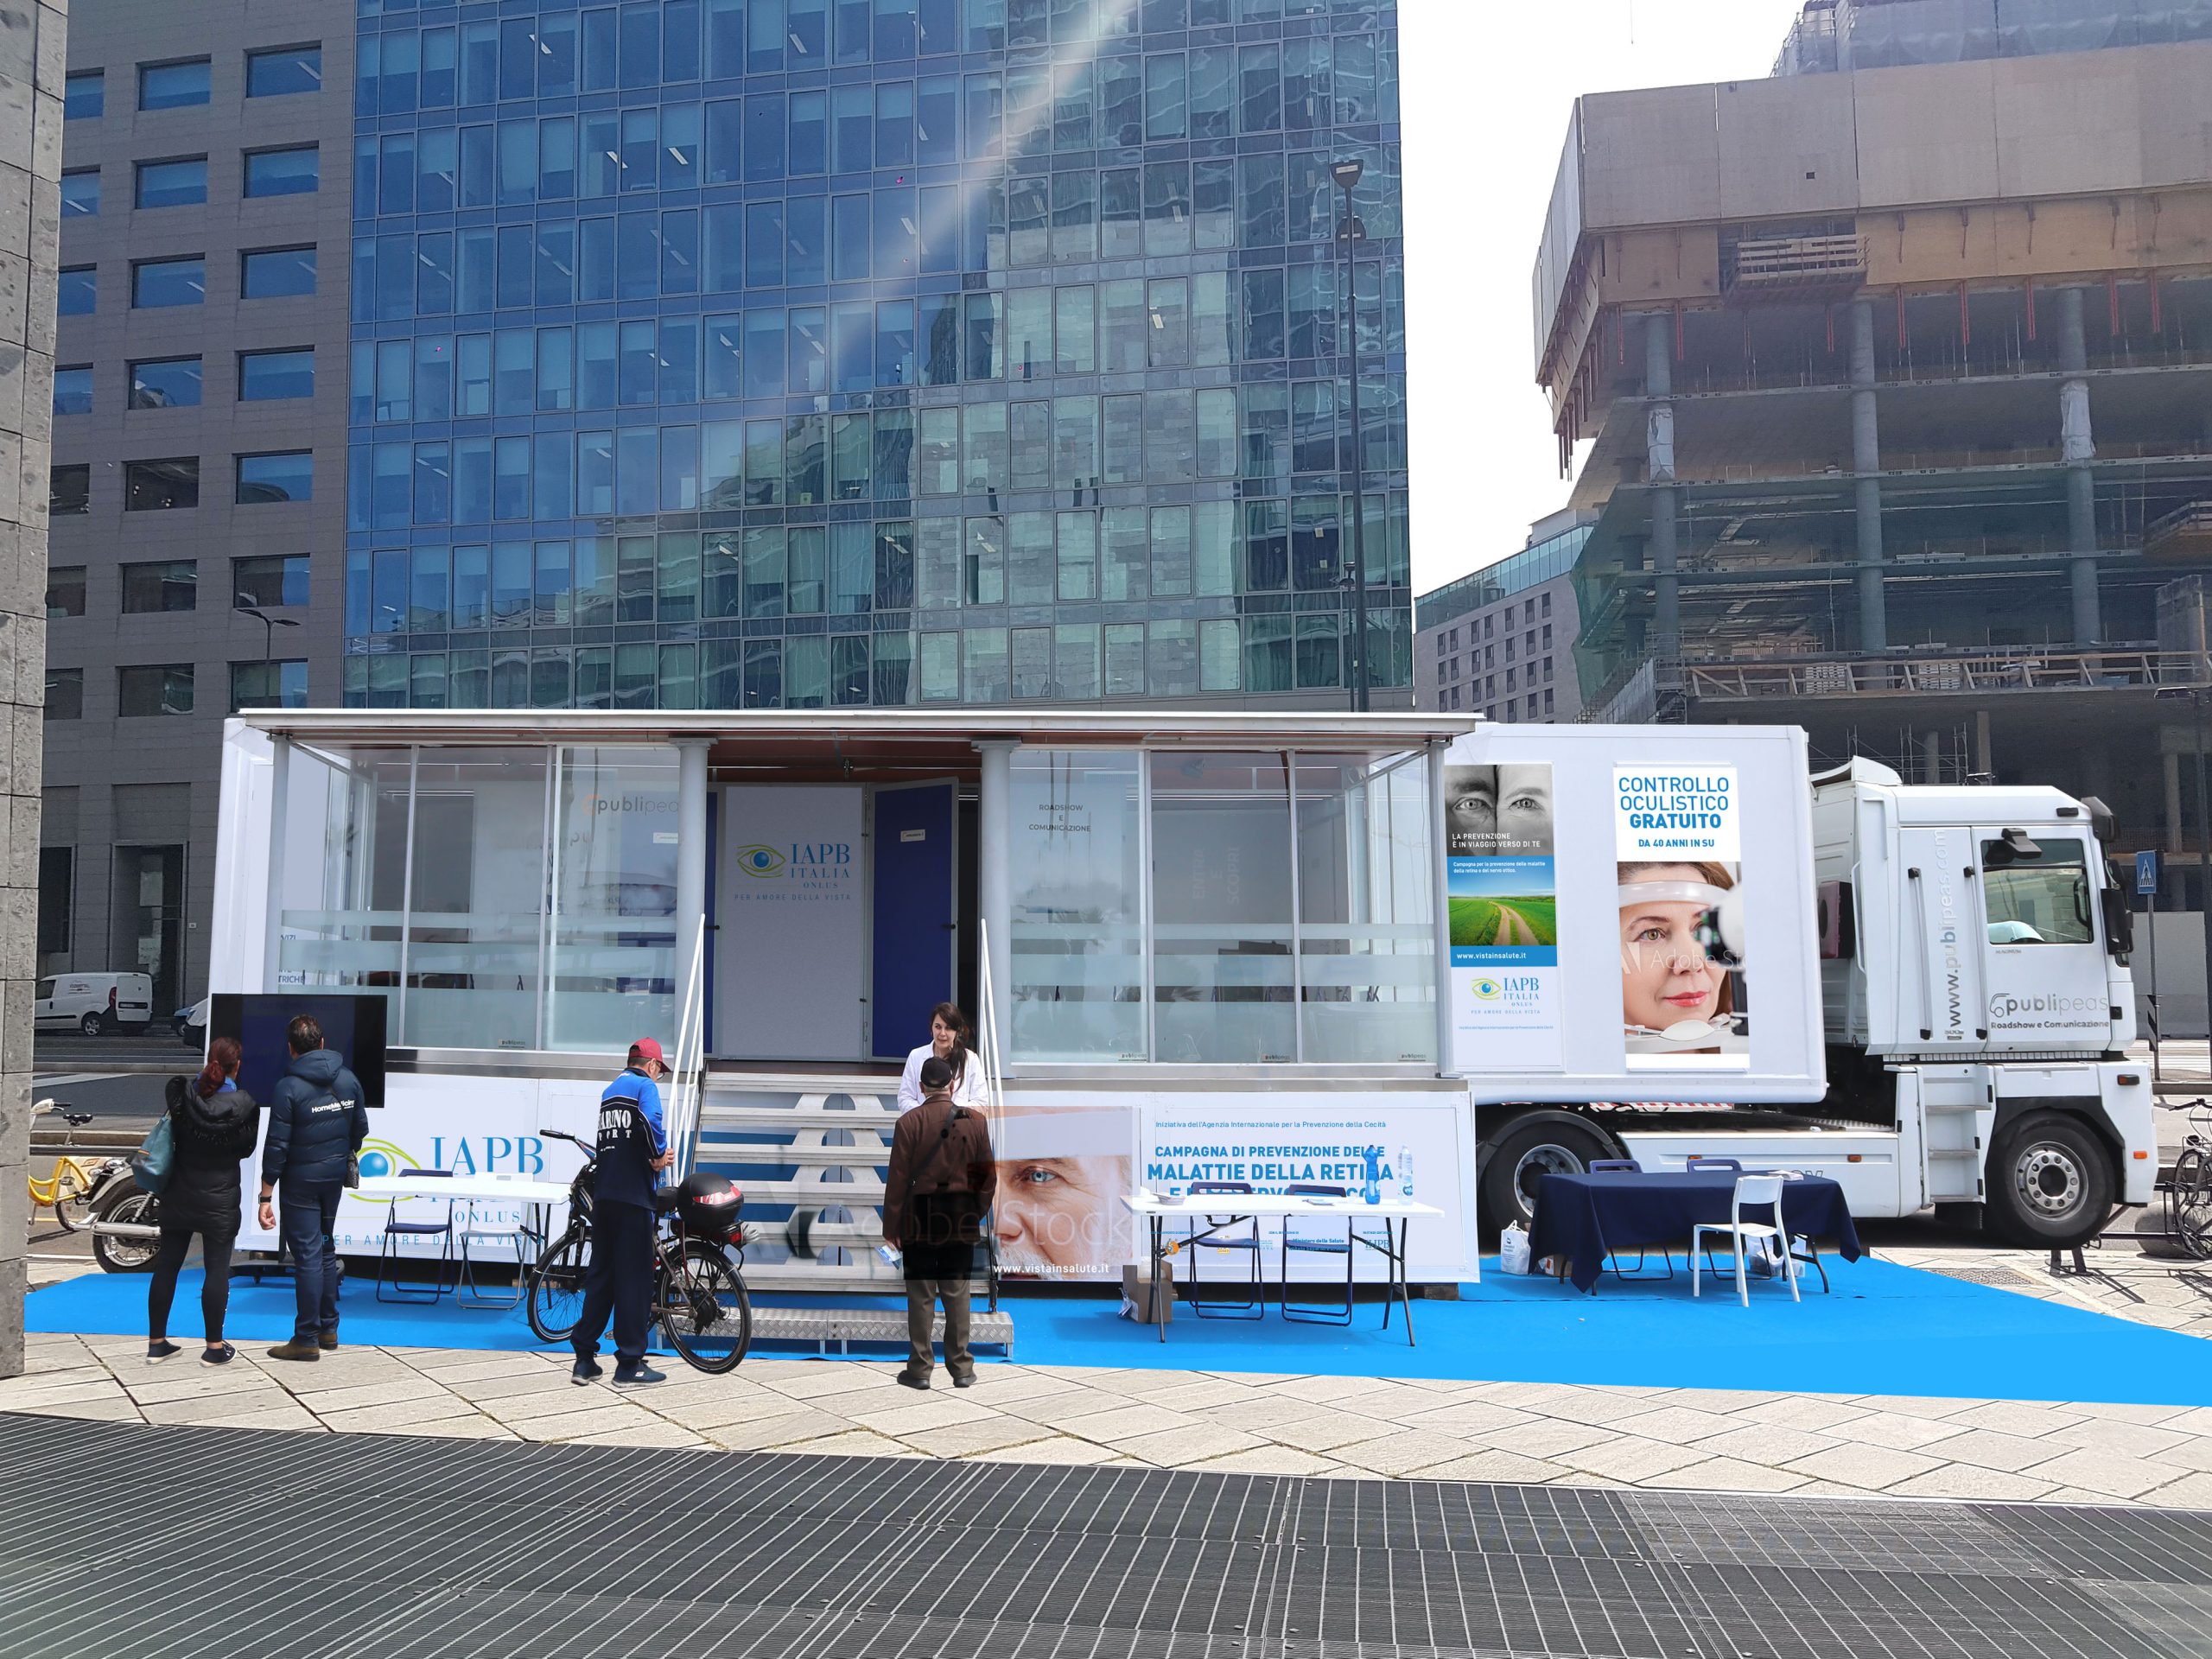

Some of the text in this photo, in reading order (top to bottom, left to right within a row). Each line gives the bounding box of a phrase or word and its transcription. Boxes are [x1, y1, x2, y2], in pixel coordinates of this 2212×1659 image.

[1618, 777, 1729, 792] CONTROLLO
[1620, 795, 1729, 810] OCULISTICO
[1028, 823, 1091, 832] COMUNICAZIONE
[1630, 813, 1722, 829] GRATUITO
[1452, 839, 1457, 849] È
[790, 843, 850, 864] IAPB
[791, 868, 850, 879] ITALIA
[1934, 830, 1962, 1027] www.publipeas.com
[1503, 977, 1540, 991] IAPB
[2005, 993, 2108, 1016] publipeas
[1187, 1121, 1230, 1129] dell'Agenzia
[429, 1136, 543, 1175] IAPB
[1155, 1147, 1385, 1157] CAMPAGNA DI PREVENZIONE DELE
[1147, 1164, 1394, 1180] MALATTIE DELLA RETIA
[454, 1211, 520, 1224] ONLUS
[323, 1235, 353, 1246] PER
[364, 1235, 421, 1246] AMORE
[433, 1235, 485, 1246] DELLA
[994, 1263, 1110, 1274] www.vistainsalute.it
